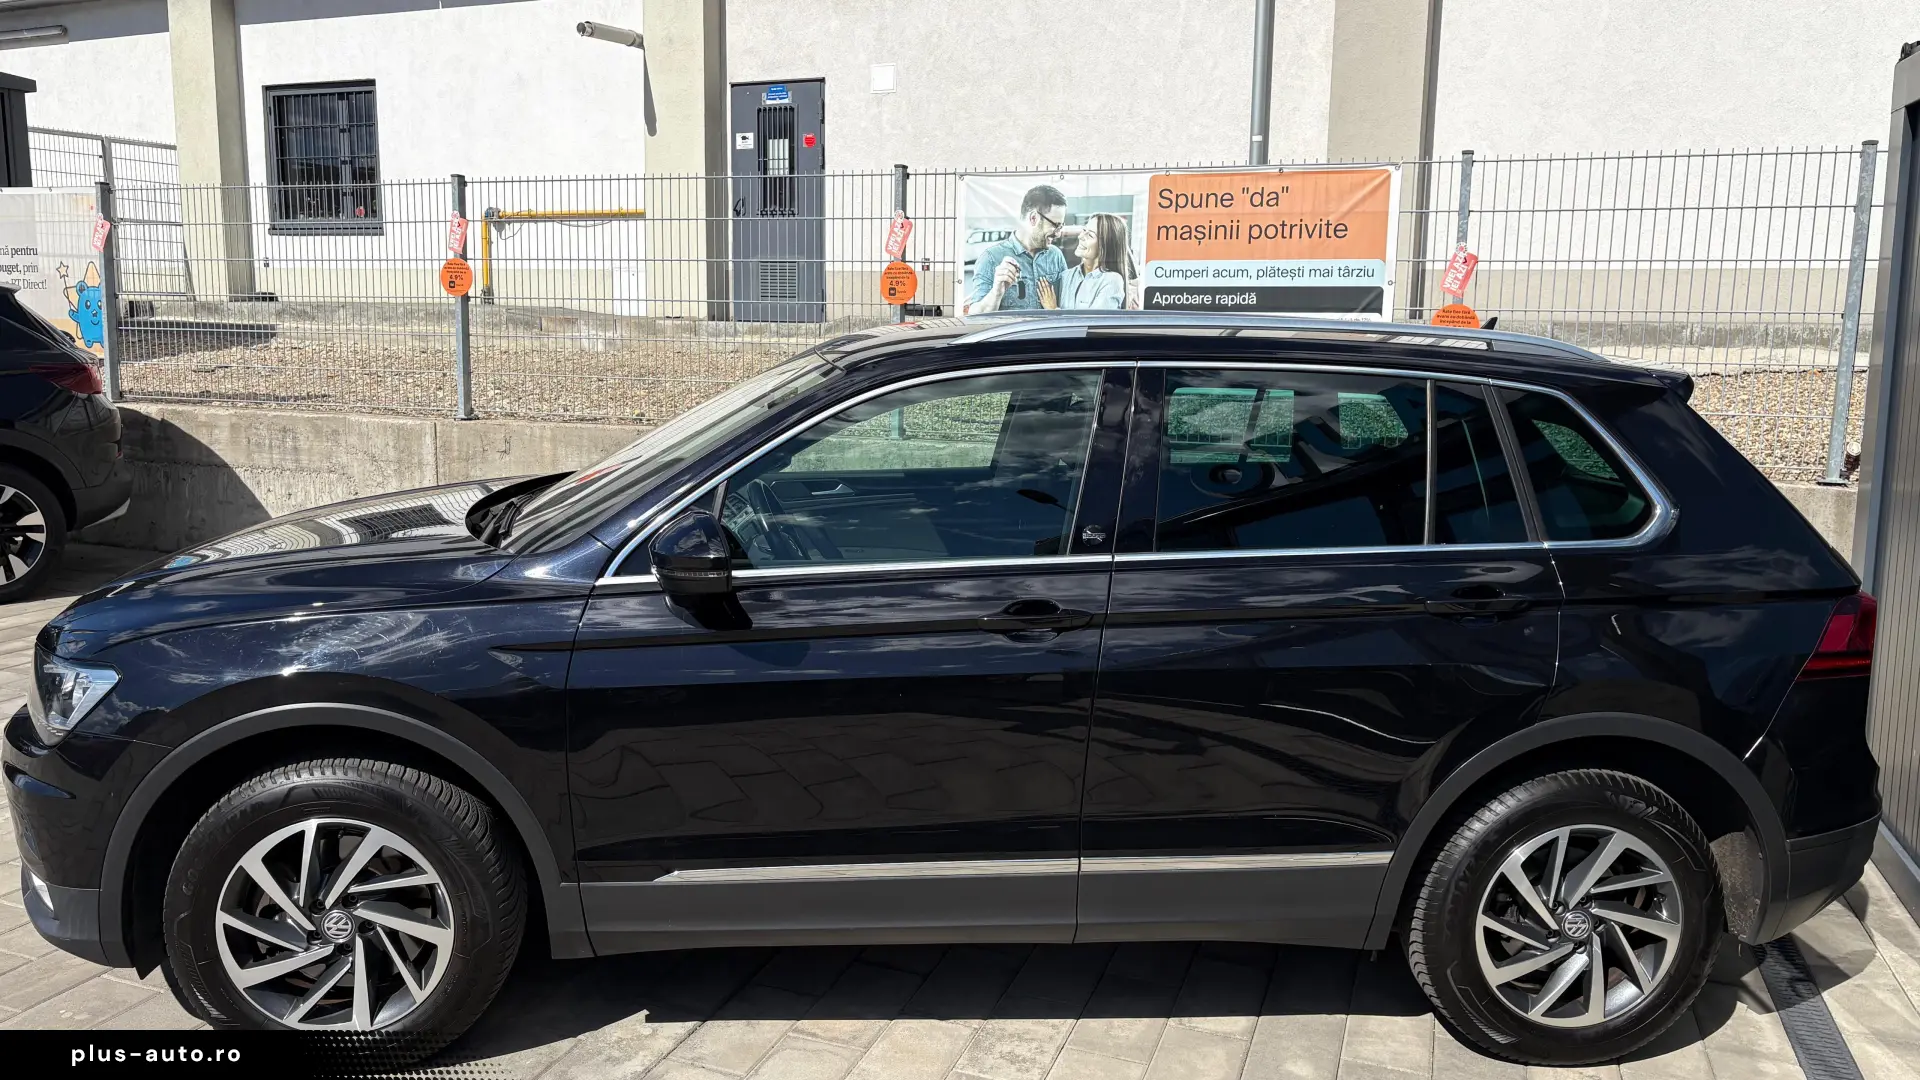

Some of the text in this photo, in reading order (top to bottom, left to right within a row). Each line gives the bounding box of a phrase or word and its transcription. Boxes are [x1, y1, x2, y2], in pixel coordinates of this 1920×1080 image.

[1157, 186, 1290, 213] Spune "da"
[1156, 218, 1349, 246] mașinii potrivite
[11, 246, 38, 258] pentru
[22, 262, 39, 275] prin
[1154, 265, 1375, 281] Cumperi acum, plătești mai târziu
[22, 279, 47, 290] Direct!
[1152, 292, 1257, 307] Aprobare rapidă
